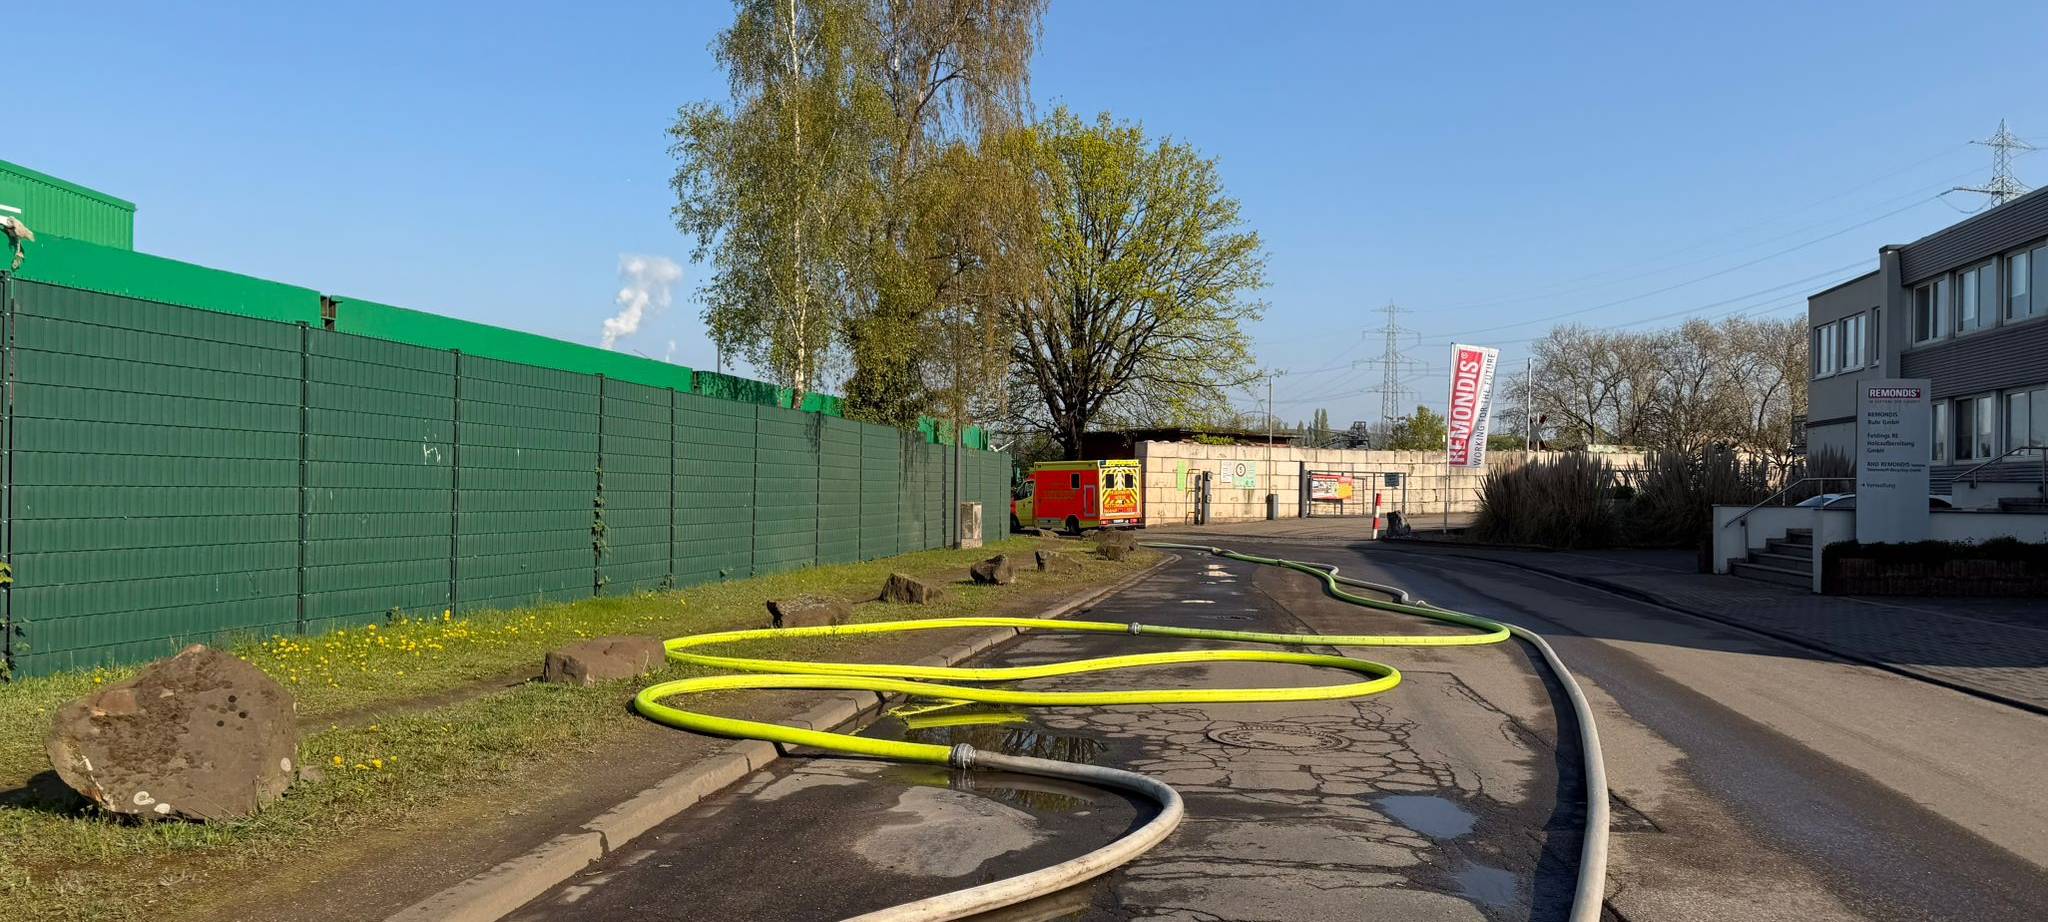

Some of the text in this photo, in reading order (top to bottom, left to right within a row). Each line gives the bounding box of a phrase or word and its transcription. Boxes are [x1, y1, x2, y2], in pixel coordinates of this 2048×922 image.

[1473, 352, 1496, 466] WORKING FOR THE FUTURE
